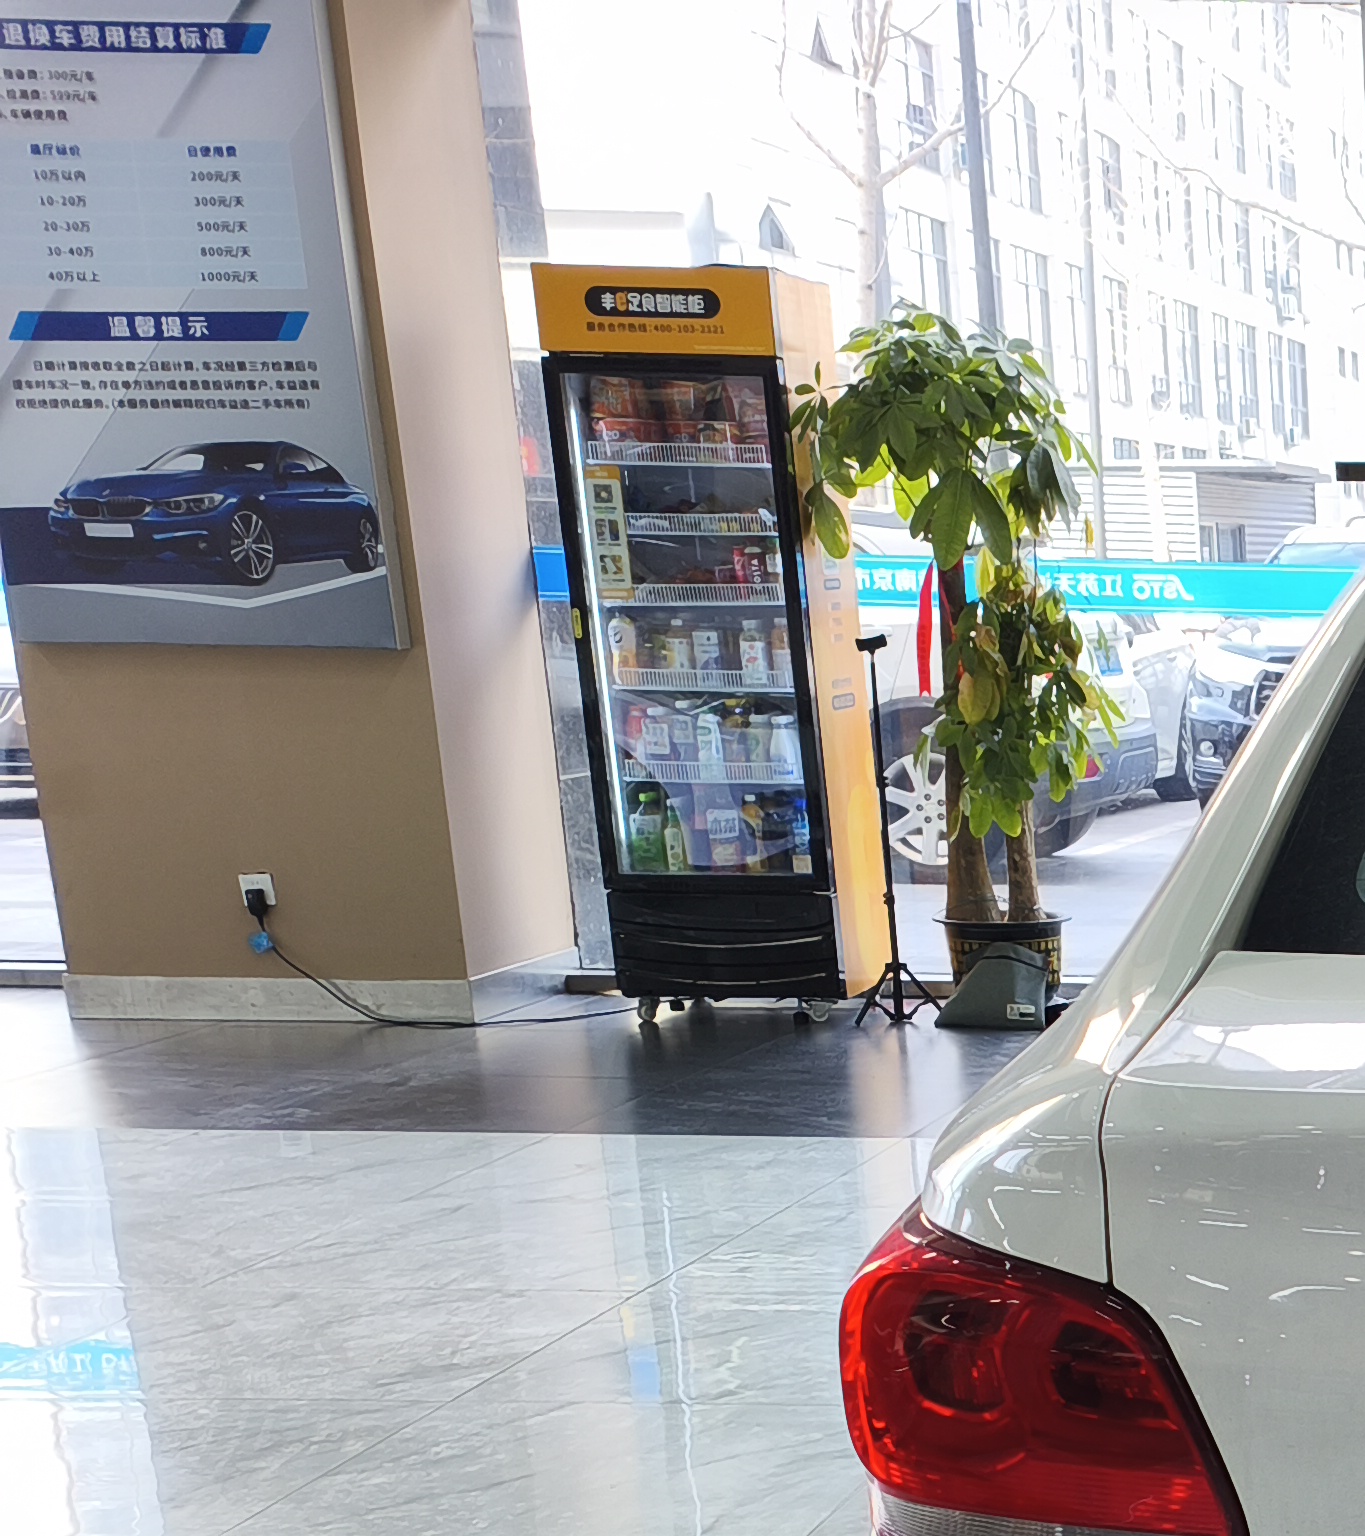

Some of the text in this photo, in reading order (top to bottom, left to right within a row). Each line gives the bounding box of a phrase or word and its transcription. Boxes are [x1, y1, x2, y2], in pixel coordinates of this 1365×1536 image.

[2, 23, 228, 50] 退换车费用结算标准
[34, 169, 87, 183] 10万以内
[190, 170, 242, 183] 200元/天
[39, 195, 87, 208] 10-20万
[194, 195, 246, 208] 300元/天
[43, 220, 91, 233] 20-30万
[197, 220, 249, 233] 500元/天
[47, 245, 95, 259] 30-40万
[200, 246, 252, 259] 800元/天
[48, 271, 101, 284] 40万以上
[200, 271, 260, 284] 1000元/天
[108, 316, 210, 338] 温馨提示
